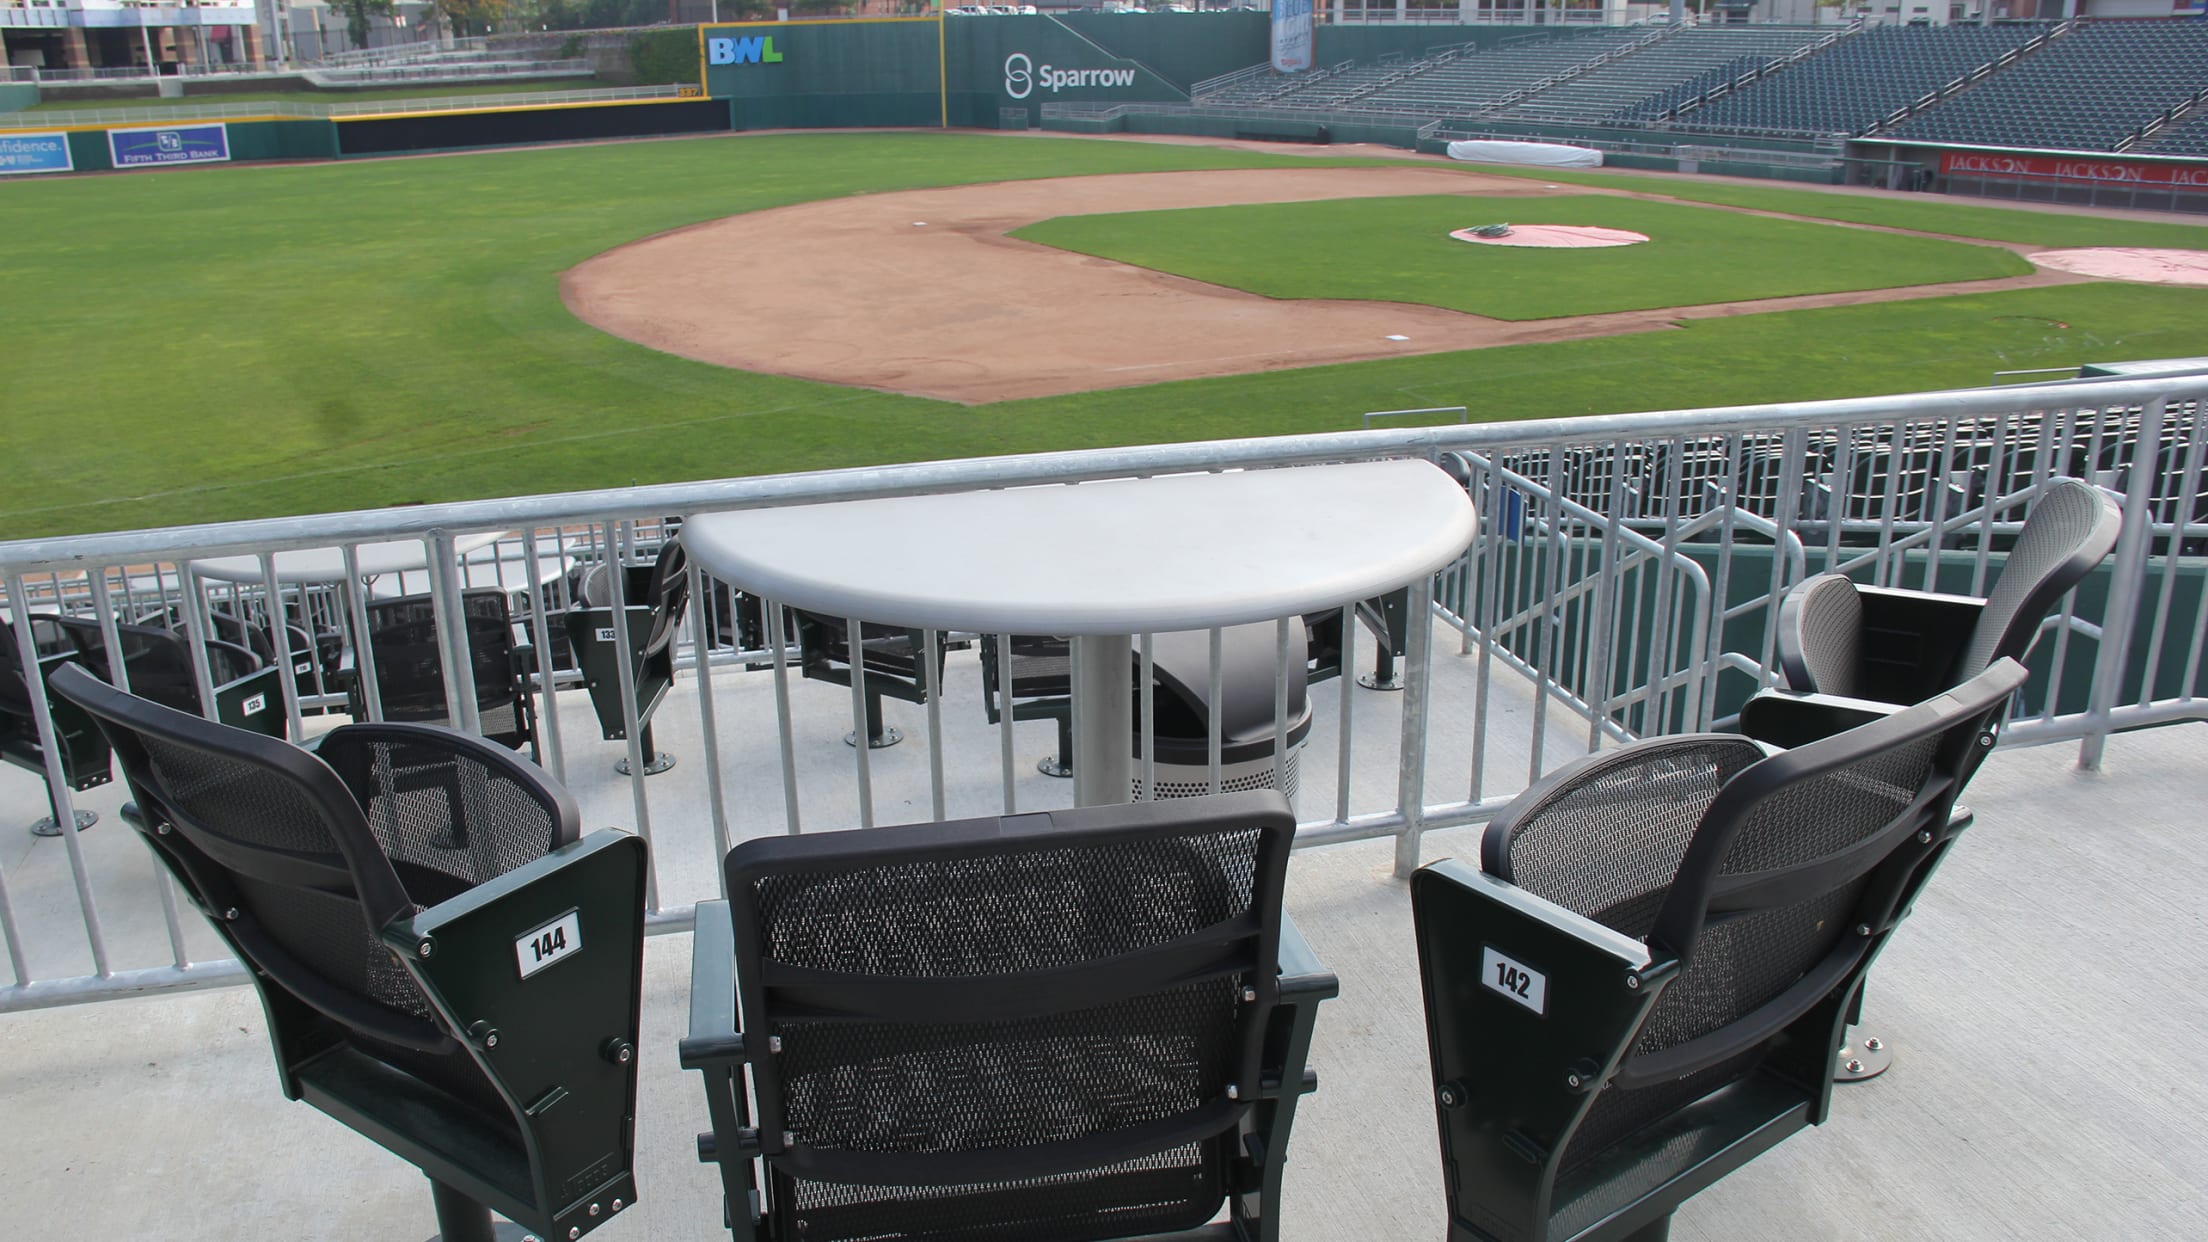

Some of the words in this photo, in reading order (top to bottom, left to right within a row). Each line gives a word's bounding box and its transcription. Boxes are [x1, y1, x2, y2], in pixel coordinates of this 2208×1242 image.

[708, 36, 783, 65] BWL
[1039, 64, 1135, 92] Sparrow
[123, 154, 152, 163] FIFTH
[155, 152, 188, 160] THIRD
[189, 149, 219, 158] BANK
[1949, 155, 2031, 173] JACKSON
[2055, 162, 2144, 182] JACKSON
[247, 699, 262, 711] 135
[530, 926, 566, 962] 144
[1496, 962, 1530, 1000] 142
